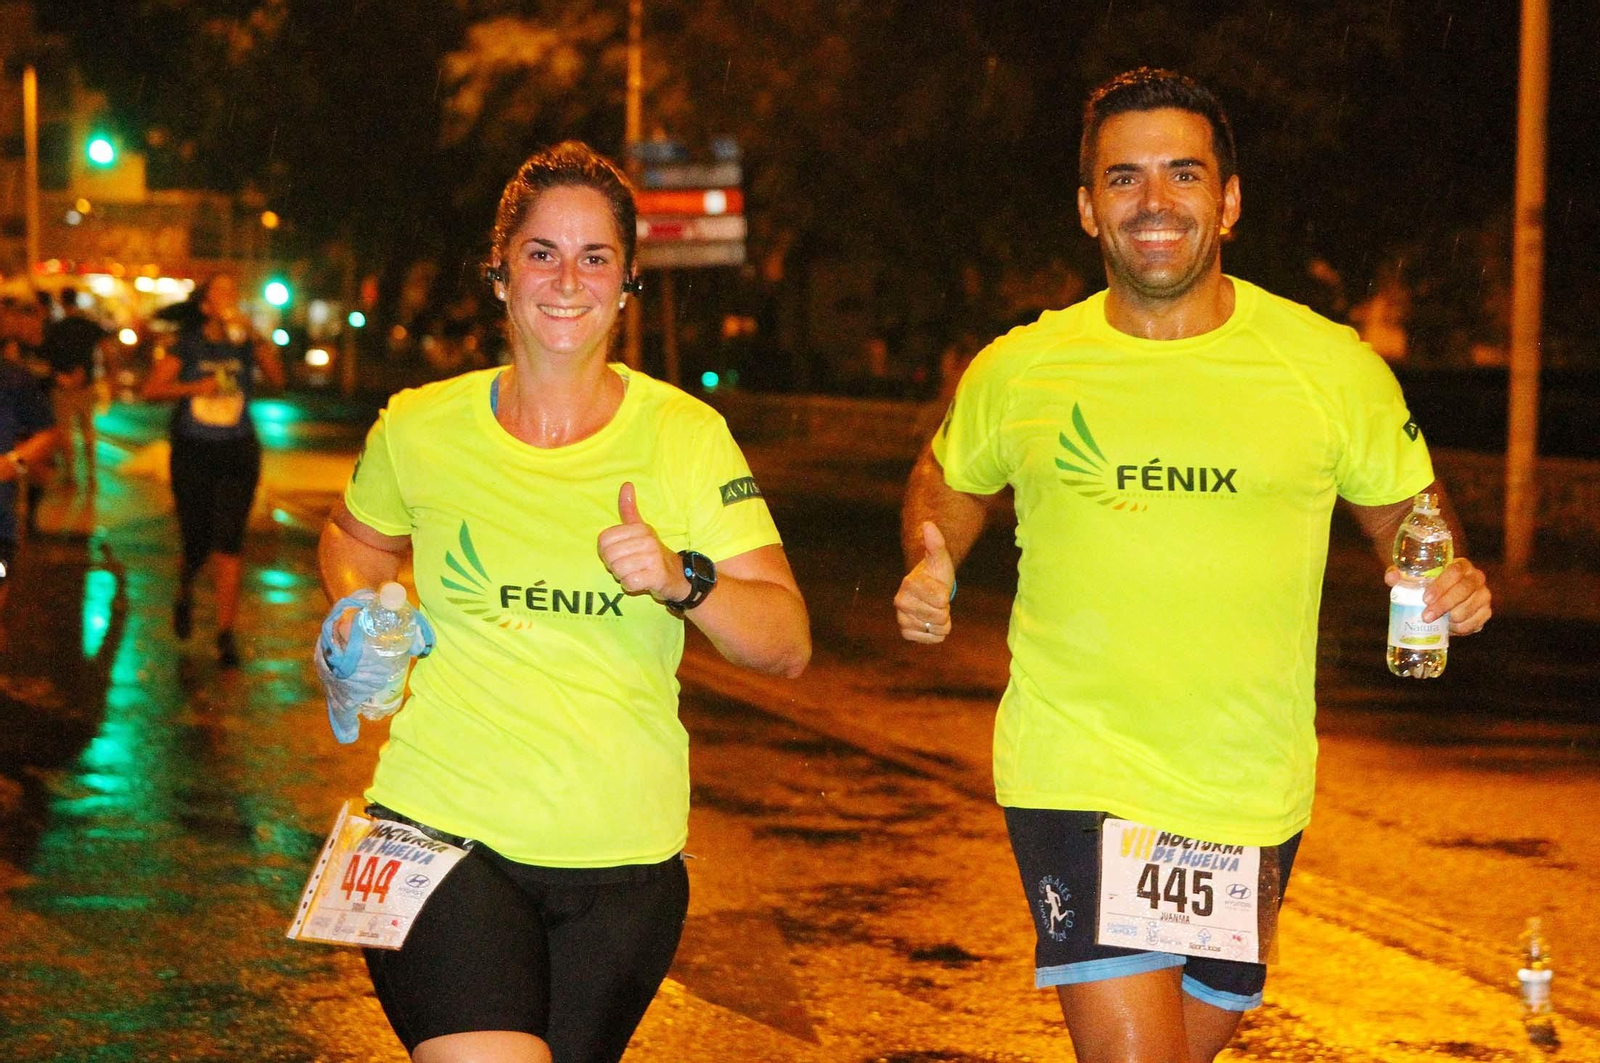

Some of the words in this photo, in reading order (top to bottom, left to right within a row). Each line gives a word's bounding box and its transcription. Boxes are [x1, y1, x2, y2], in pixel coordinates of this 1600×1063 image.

[1116, 457, 1238, 493] FÉNIX
[500, 579, 625, 616] FÉNIX
[1404, 621, 1440, 632] Natura
[367, 824, 450, 853] NOCTURNA
[374, 840, 436, 865] HUELVA
[1151, 846, 1176, 863] DE
[1177, 849, 1240, 872] HUELVA
[340, 854, 402, 903] 444
[1136, 863, 1214, 917] 445
[1160, 911, 1190, 924] JUANMA
